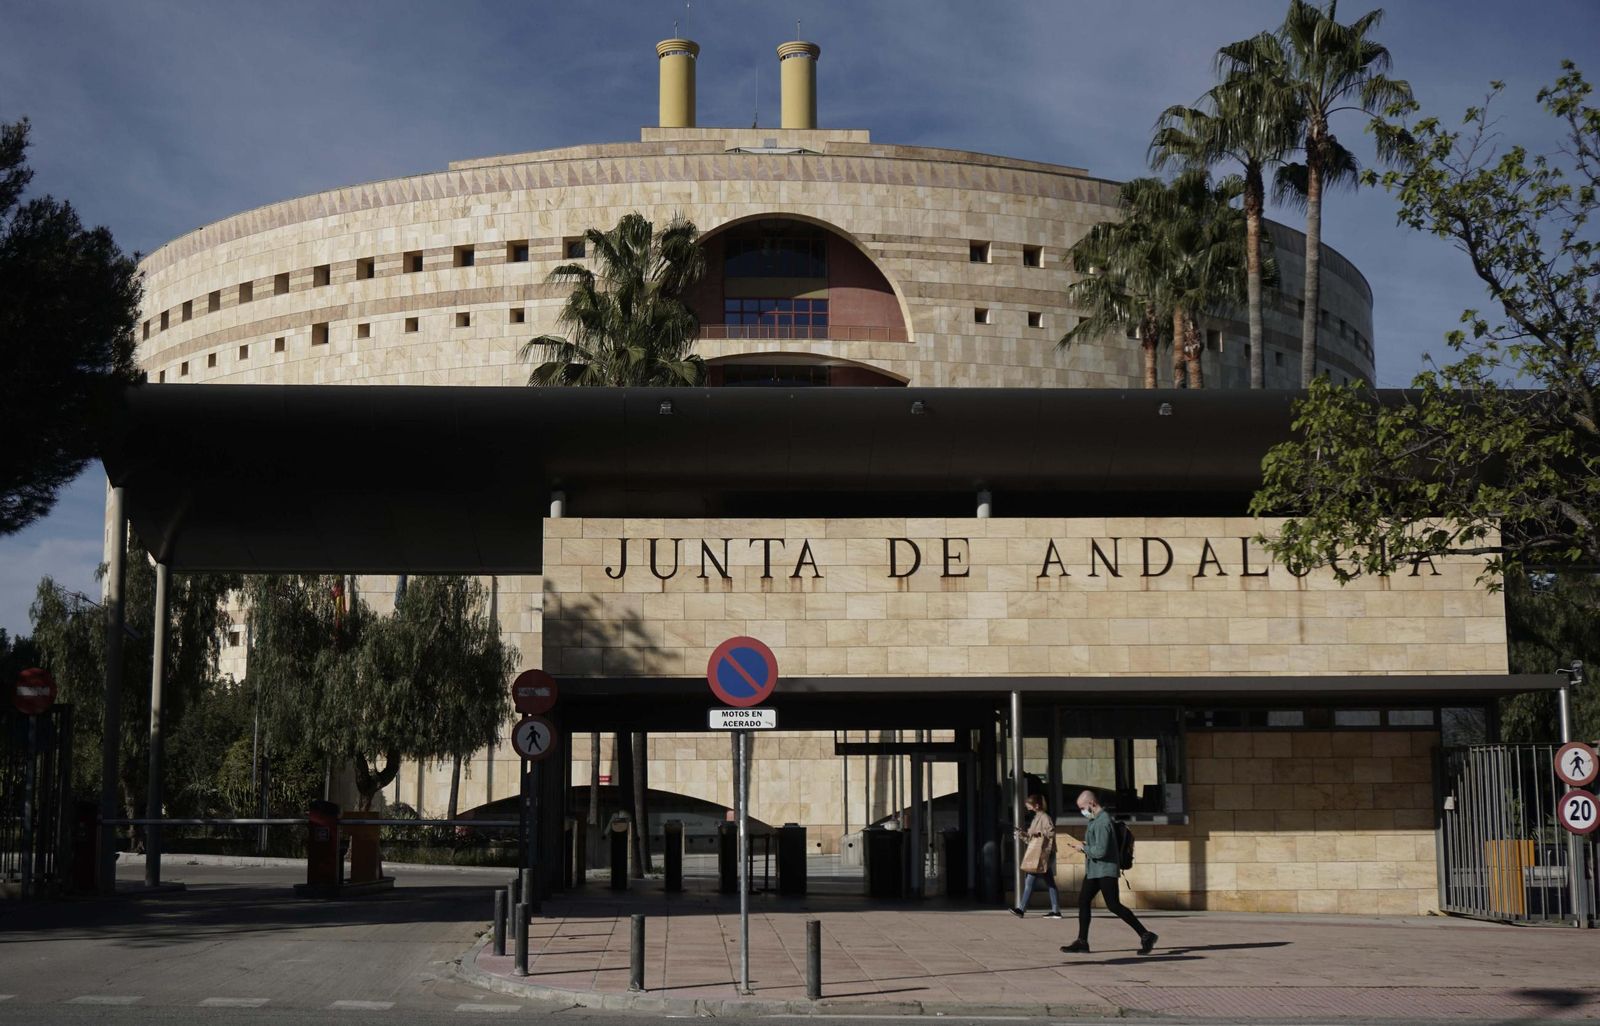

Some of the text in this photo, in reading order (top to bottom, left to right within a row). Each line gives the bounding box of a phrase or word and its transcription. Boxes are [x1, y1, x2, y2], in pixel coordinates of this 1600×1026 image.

[605, 538, 824, 580] JUNTA
[886, 537, 970, 578] DE
[1570, 800, 1591, 821] 20
